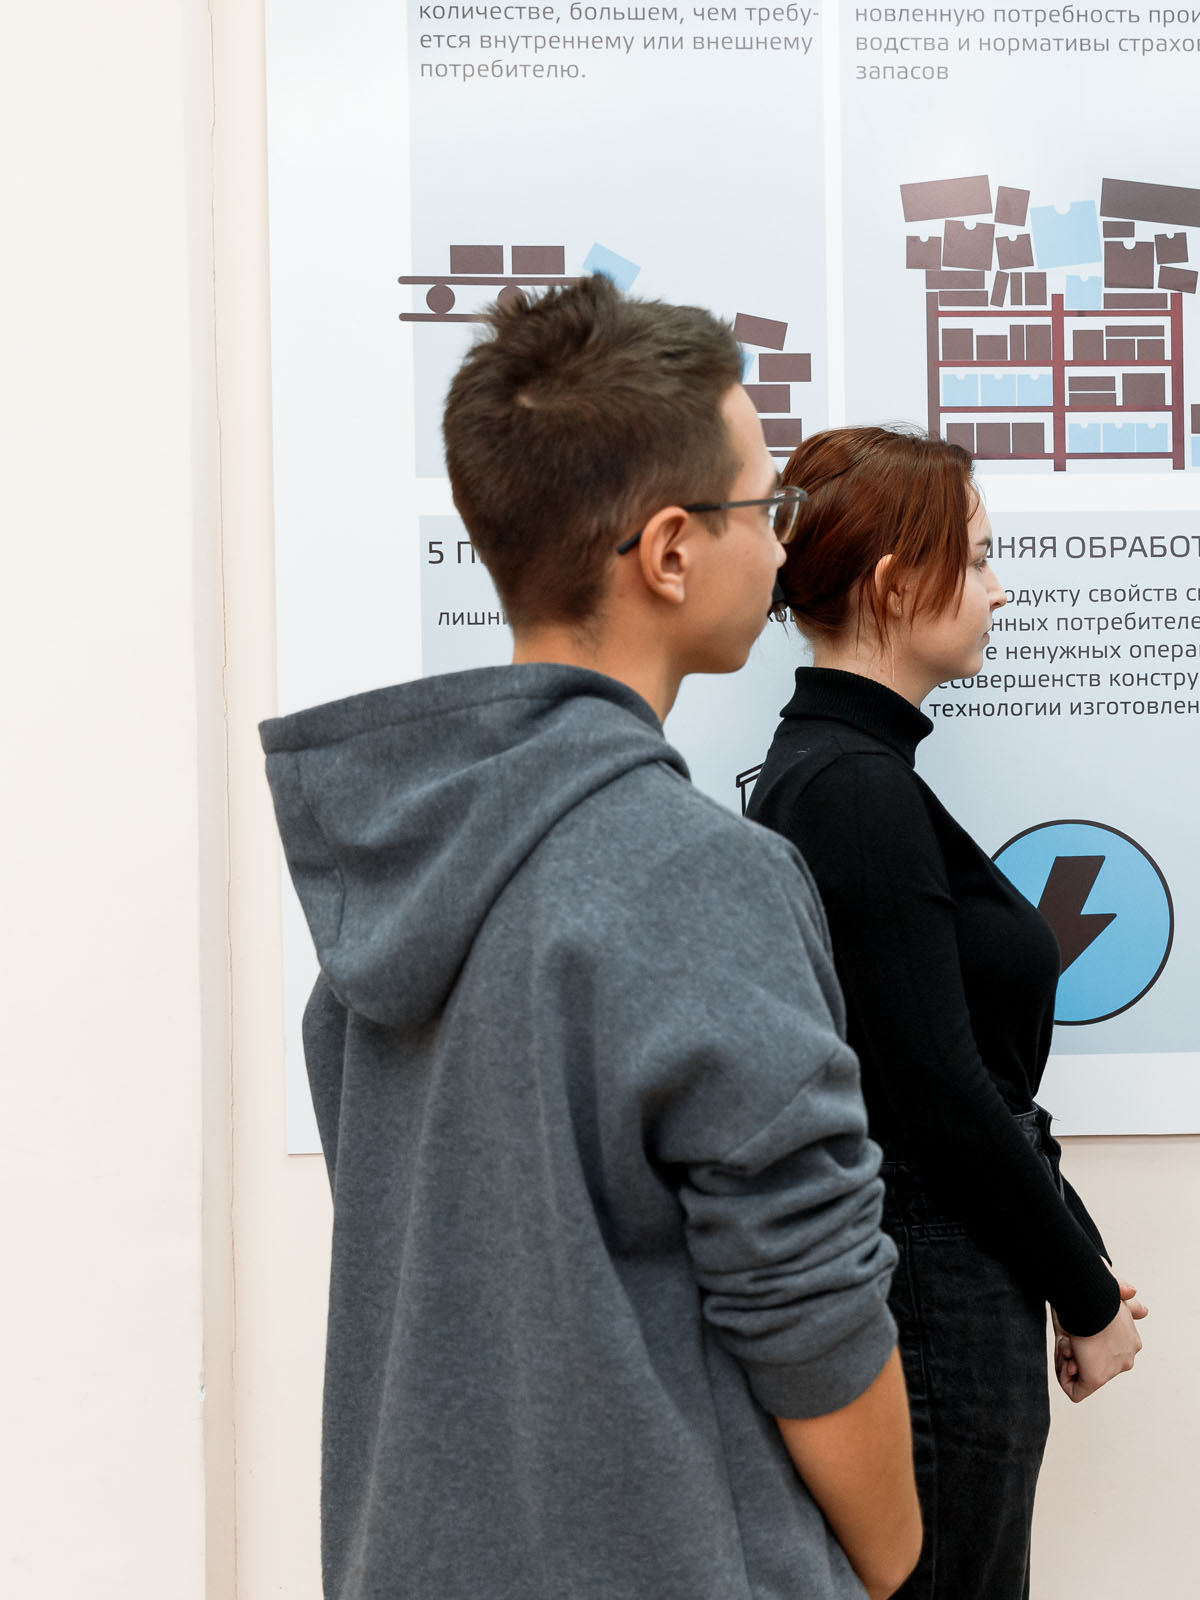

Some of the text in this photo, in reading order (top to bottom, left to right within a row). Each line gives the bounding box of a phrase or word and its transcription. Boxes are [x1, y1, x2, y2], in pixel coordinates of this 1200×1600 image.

[419, 2, 820, 27] количестве, большем, чем требу-
[855, 7, 985, 28] новленную
[993, 4, 1141, 28] потребность
[419, 33, 813, 56] ется внутреннему или внешнему
[855, 36, 949, 55] водства
[957, 37, 970, 52] и
[978, 37, 1110, 57] нормативы
[420, 58, 586, 83] потребителю.
[855, 65, 949, 80] запасов
[428, 540, 444, 565] 5
[987, 535, 1057, 559] НЯЯ
[1004, 587, 1081, 607] одукту
[1088, 583, 1178, 603] свойств
[992, 617, 1049, 632] нных
[1005, 644, 1122, 665] ненужных
[928, 701, 1062, 718] технологии
